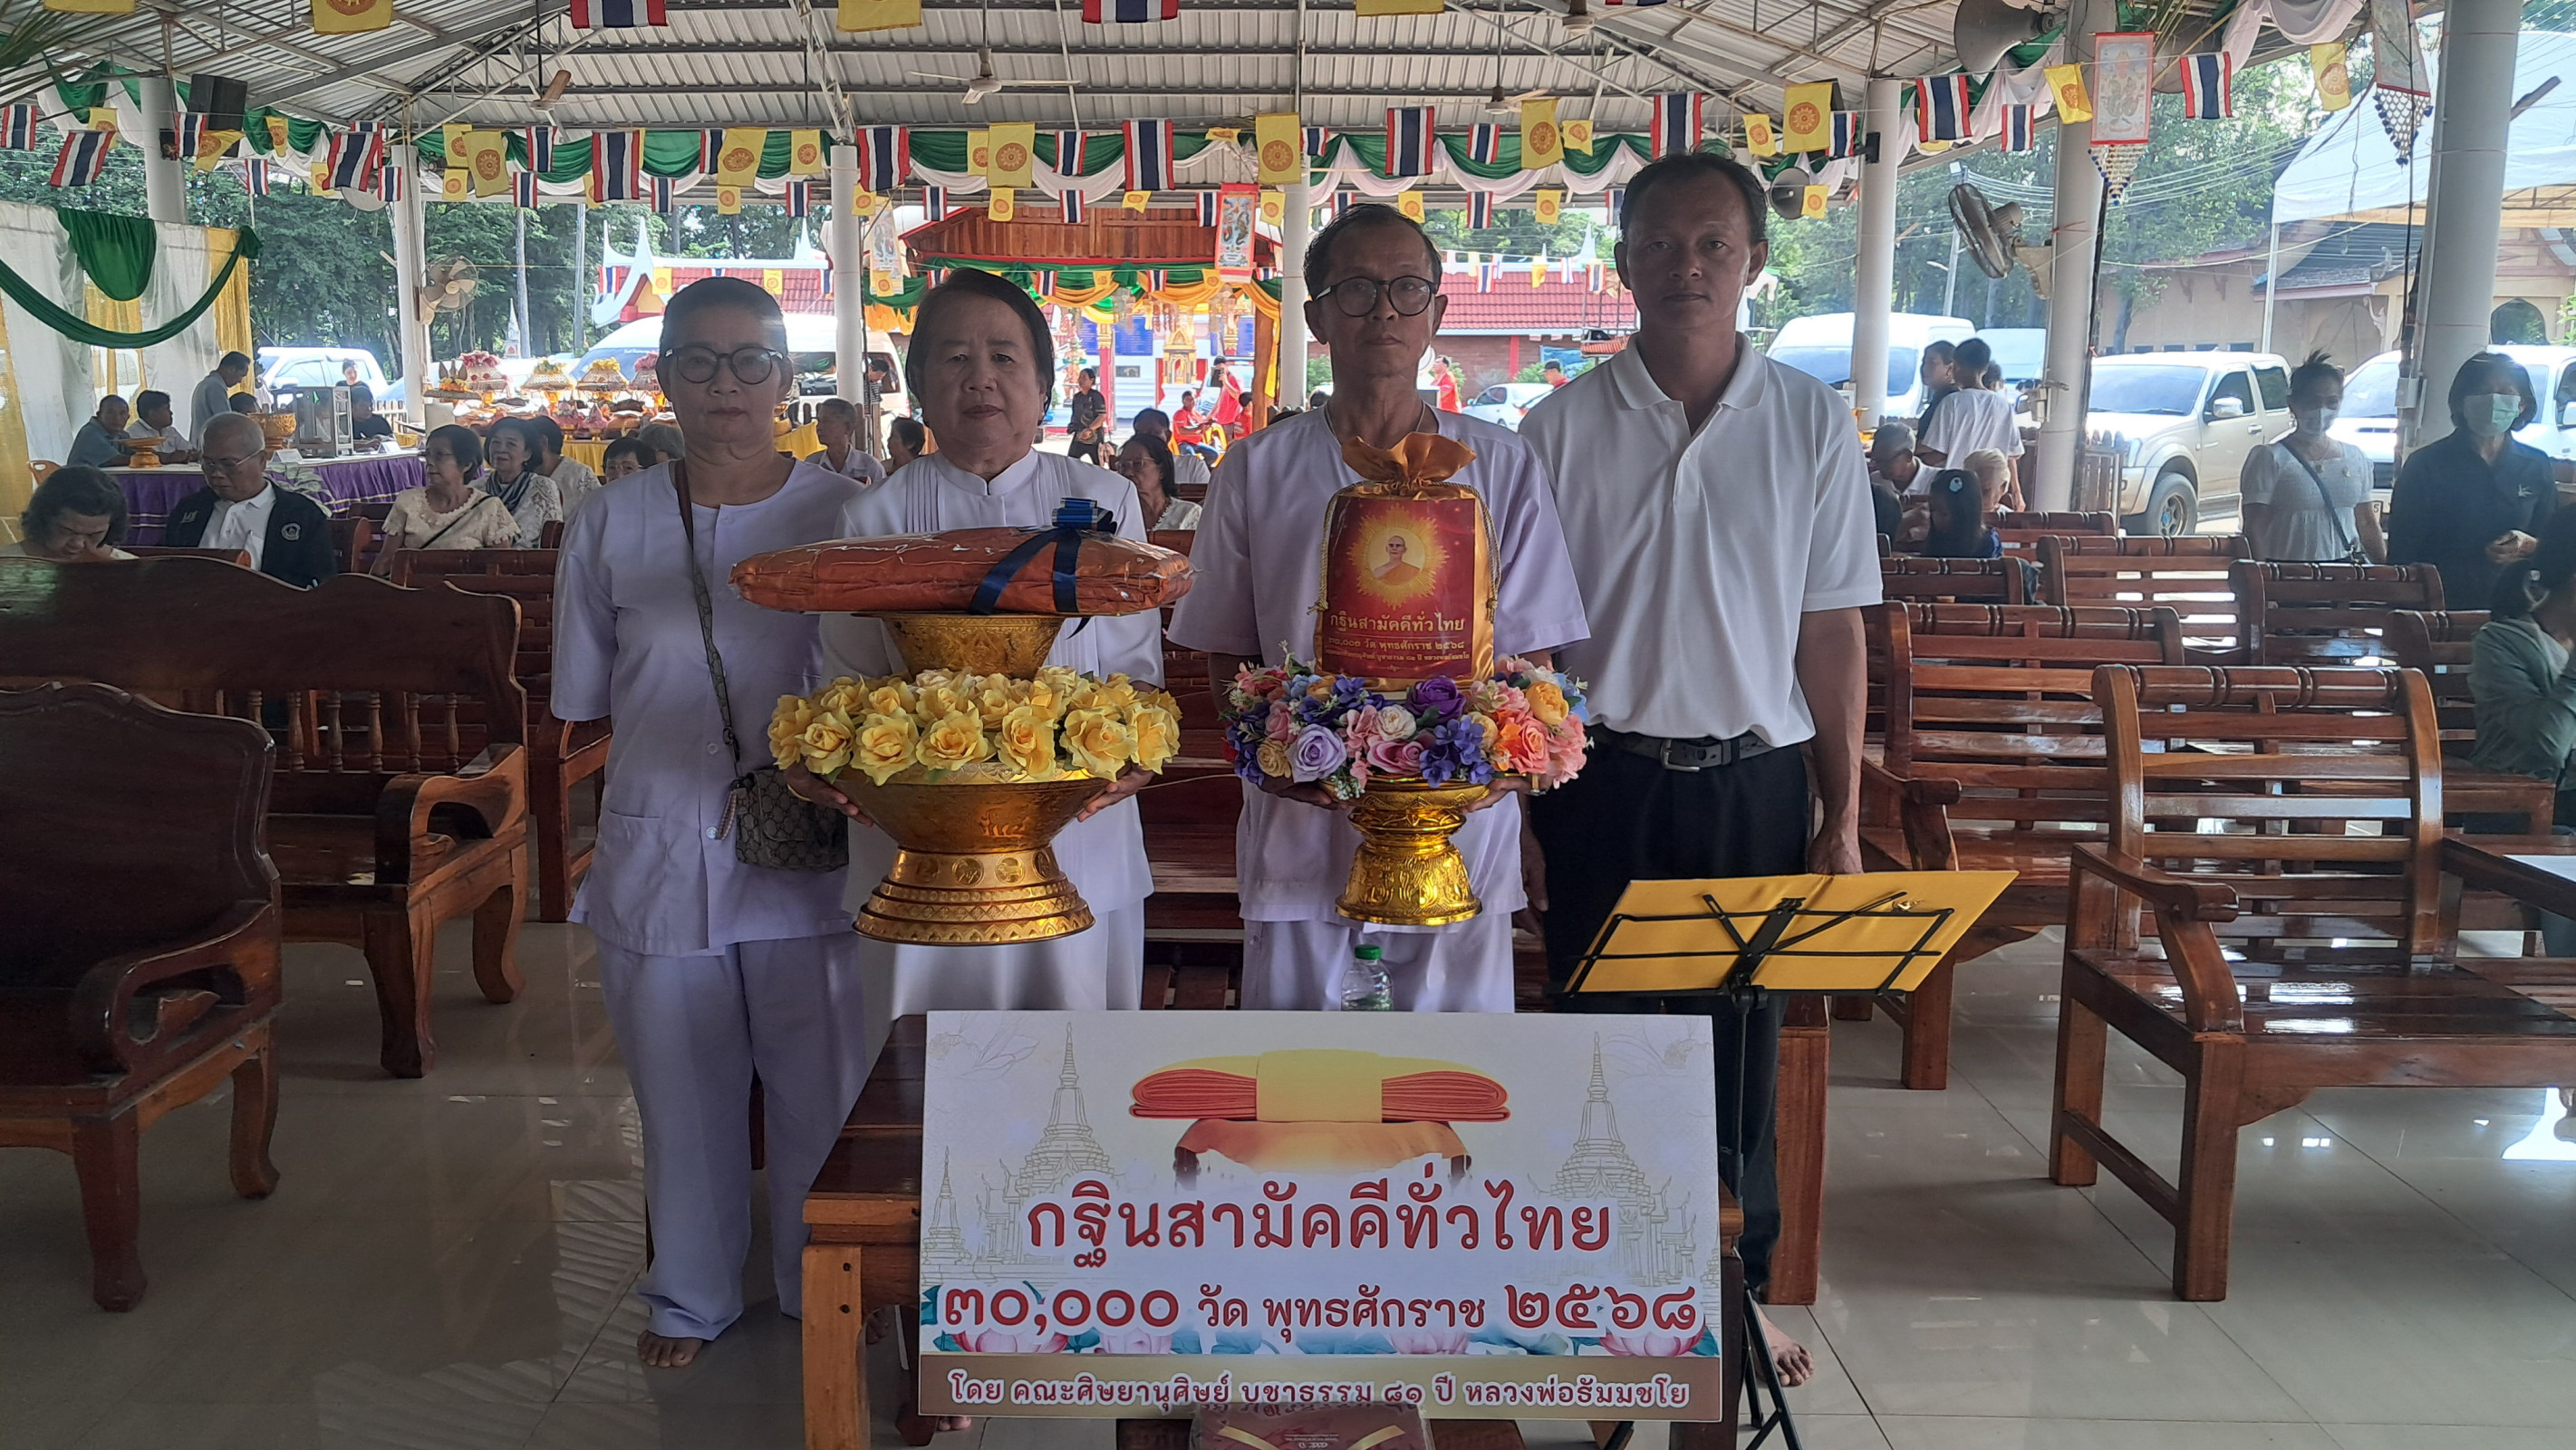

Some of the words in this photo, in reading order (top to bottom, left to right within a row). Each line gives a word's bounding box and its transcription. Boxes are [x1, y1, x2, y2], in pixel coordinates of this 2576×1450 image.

[1330, 610, 1465, 632] กฐินสามัคคีทั่วไทย
[1364, 637, 1376, 649] วัด
[1028, 1162, 1609, 1267] กฐินสามัคคีทั่วไทย
[945, 1289, 1179, 1336] ๓๐,๐๐๐
[1198, 1283, 1248, 1328] วัด
[1262, 1284, 1486, 1343] พุทธศักราช
[1504, 1283, 1696, 1330] ๒๕๖๘
[950, 1373, 1001, 1401] โดย
[1014, 1372, 1230, 1412] คณะศิษยานุศิษย์
[1241, 1384, 1371, 1404] บชาธรรม
[1384, 1385, 1423, 1404] ๘๑
[1435, 1374, 1453, 1402] ปี
[1466, 1377, 1687, 1404] หลวงพ่อธัมมชโย
